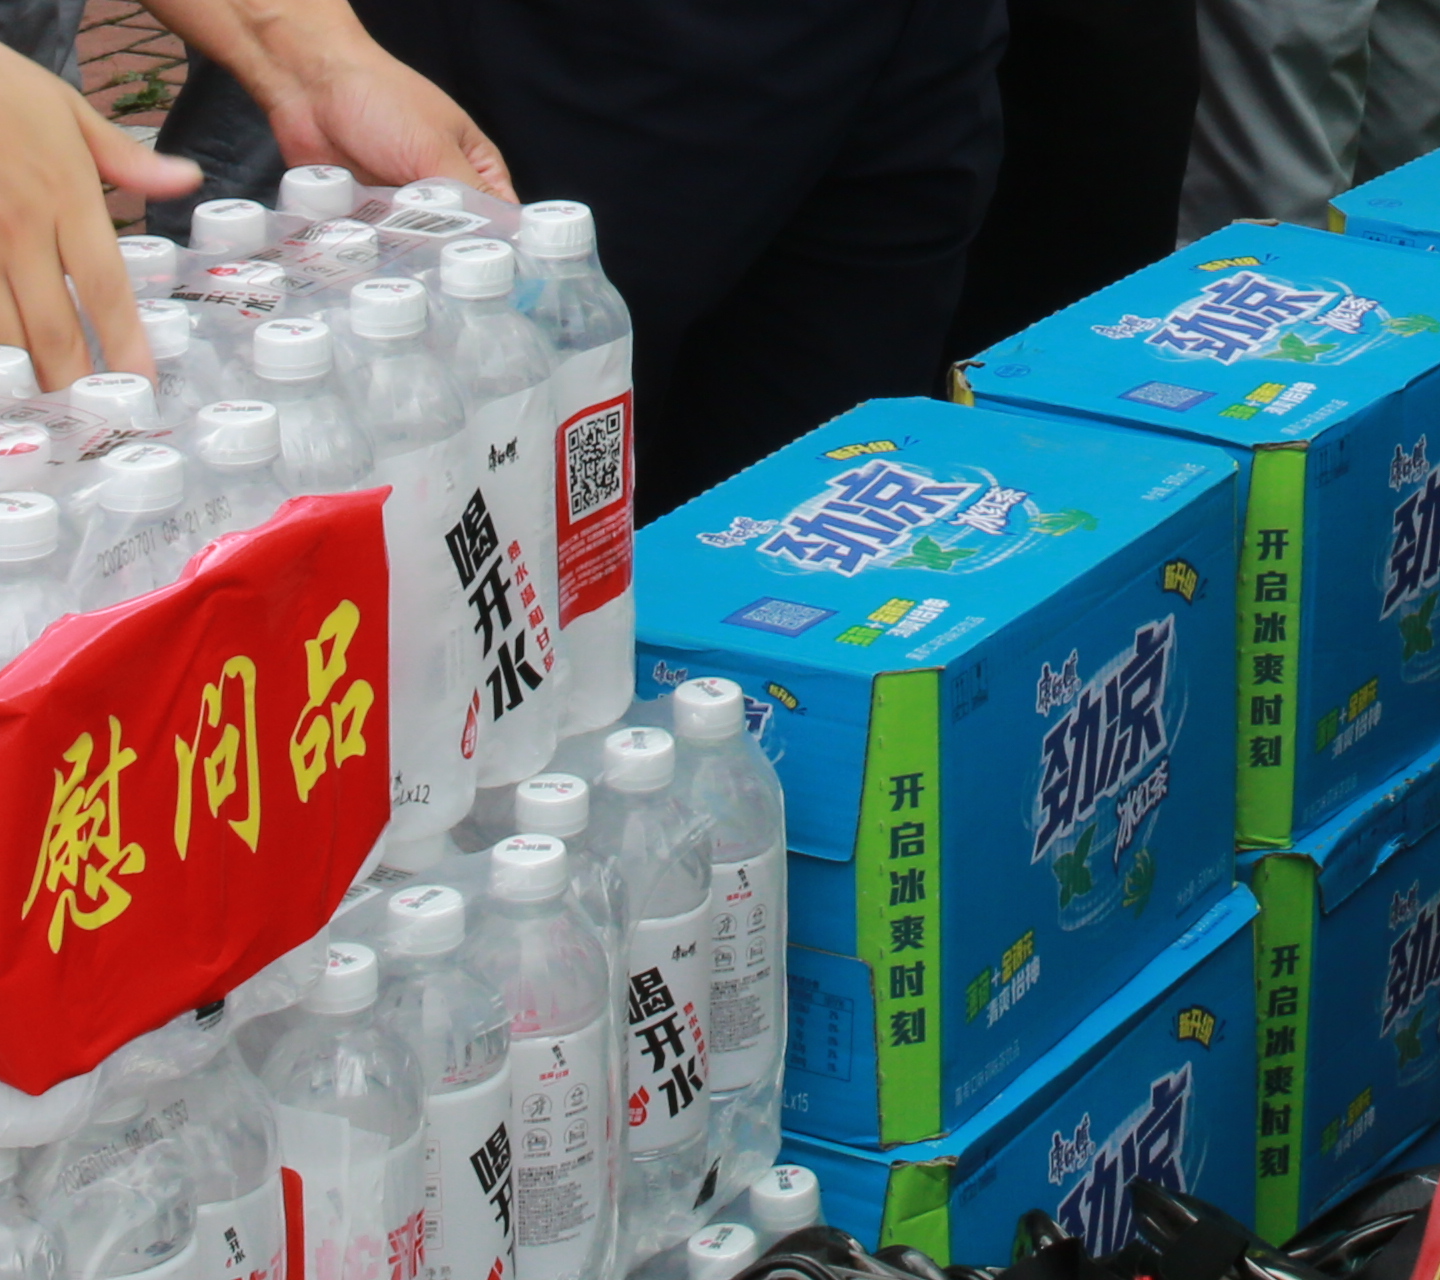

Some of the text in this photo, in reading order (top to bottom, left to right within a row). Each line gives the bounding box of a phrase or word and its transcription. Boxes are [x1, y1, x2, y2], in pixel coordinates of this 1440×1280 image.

[1144, 271, 1340, 366] 劲凉
[445, 486, 544, 722] 喝开水
[756, 458, 982, 578] 劲凉
[1030, 612, 1175, 866] 劲凉
[1248, 528, 1291, 768] 开启冰爽时刻
[21, 598, 378, 956] 慰问品
[888, 771, 927, 1047] 开启冰爽时刻
[628, 966, 704, 1119] 喝开水
[1262, 942, 1301, 1178] 开启冰爽时刻
